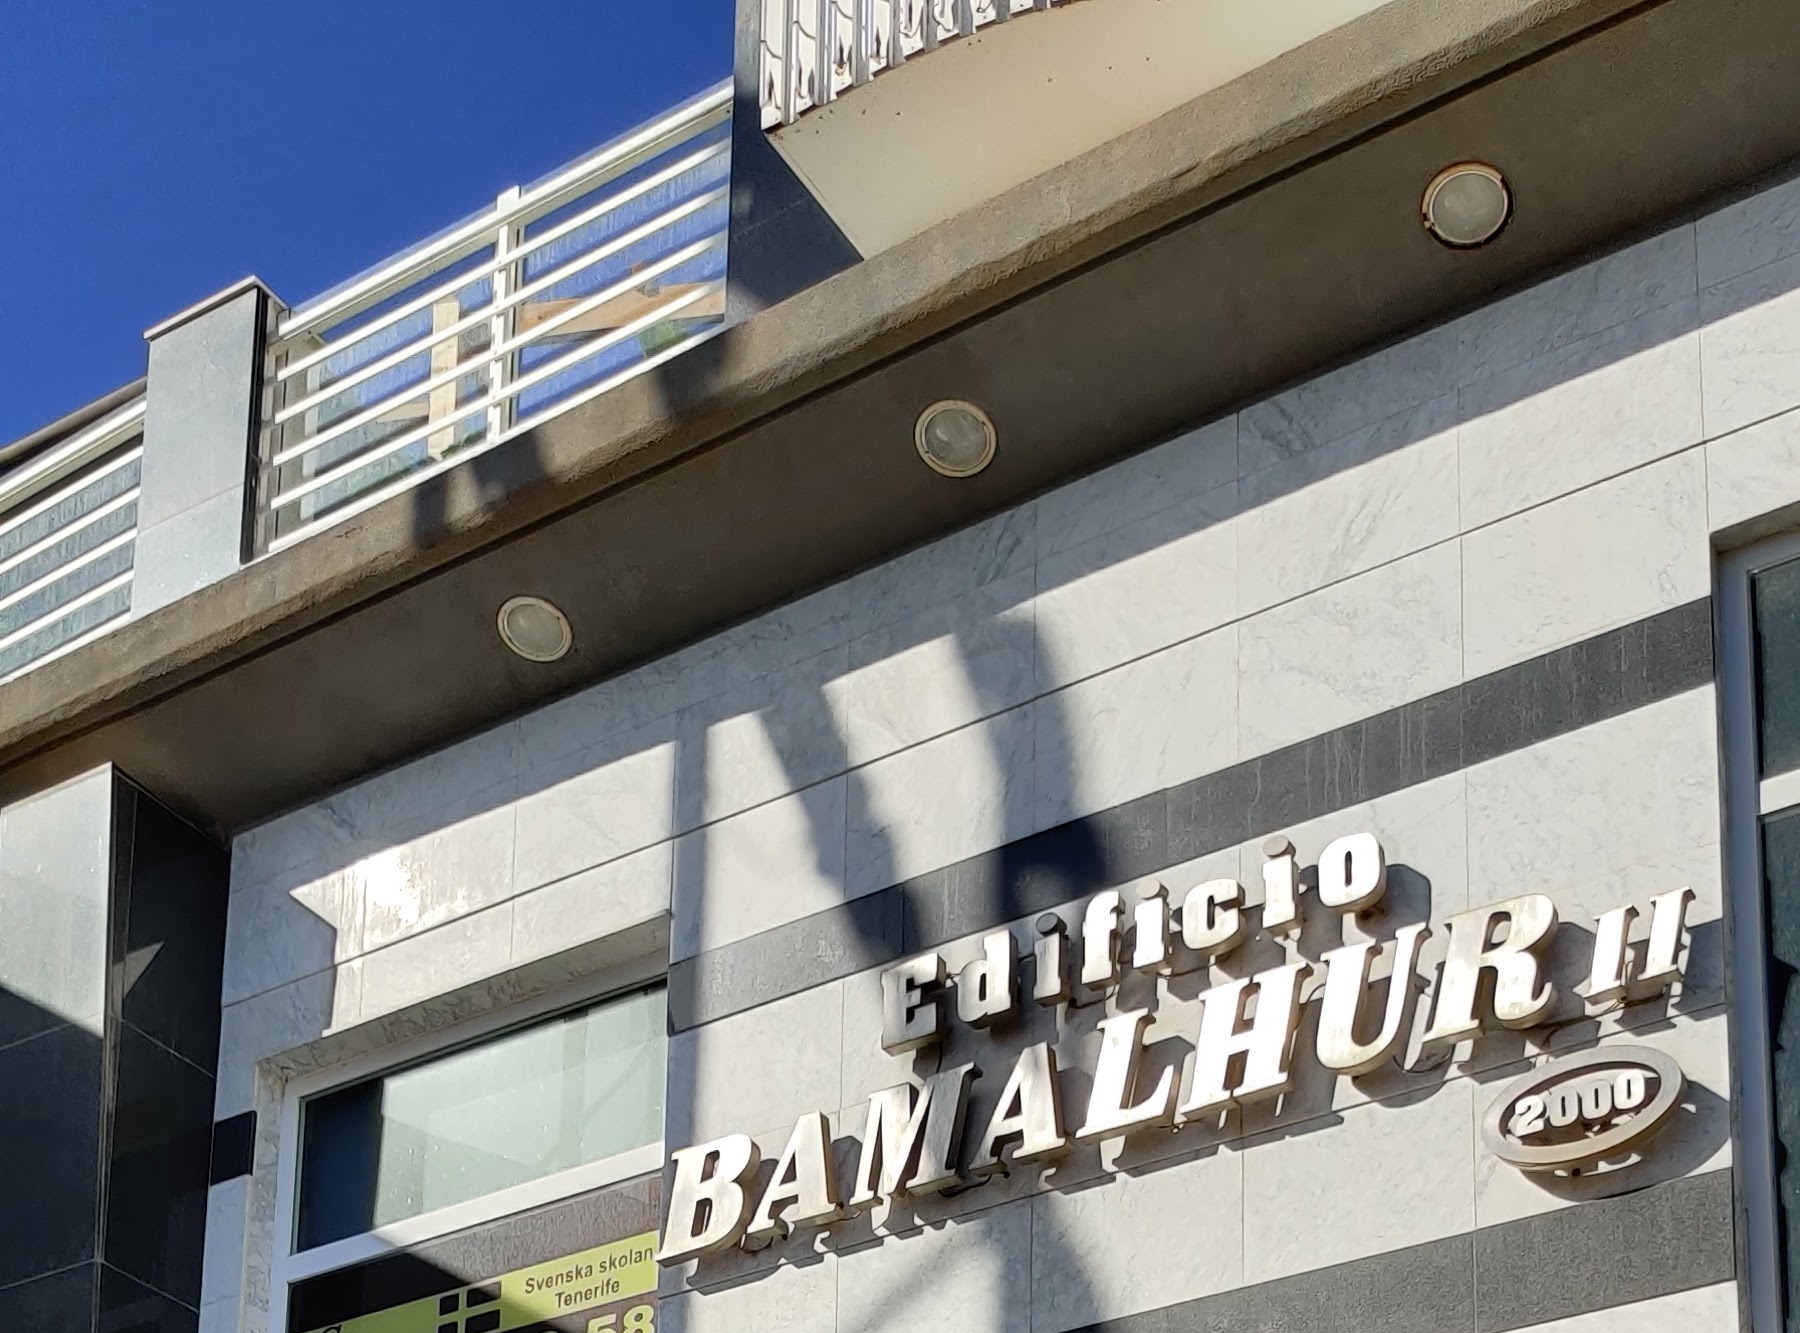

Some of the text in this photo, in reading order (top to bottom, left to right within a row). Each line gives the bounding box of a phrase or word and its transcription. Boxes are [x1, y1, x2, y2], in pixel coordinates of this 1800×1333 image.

[881, 831, 1387, 1056] Edificio
[656, 892, 1559, 1266] BAMALHUR
[1513, 1070, 1647, 1135] 2000
[524, 1246, 654, 1295] Svenska skolan
[555, 1278, 621, 1309] Tenerife
